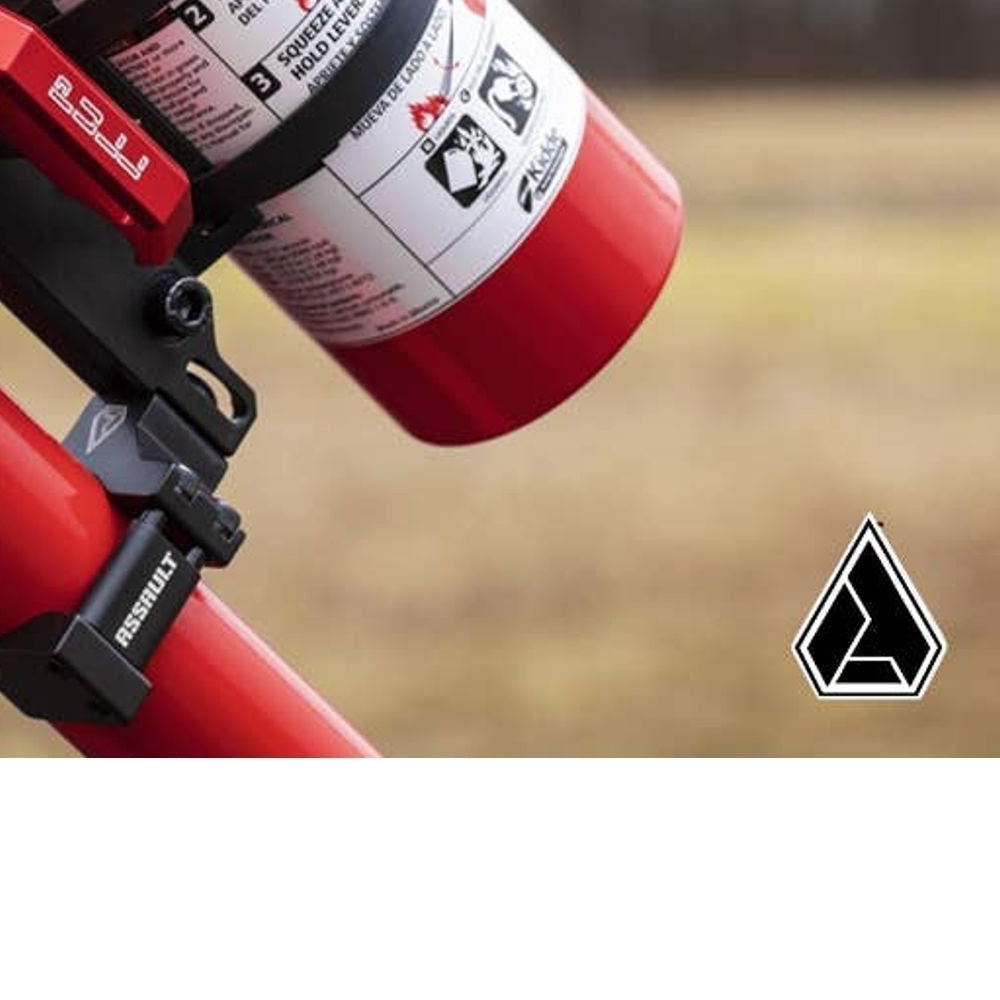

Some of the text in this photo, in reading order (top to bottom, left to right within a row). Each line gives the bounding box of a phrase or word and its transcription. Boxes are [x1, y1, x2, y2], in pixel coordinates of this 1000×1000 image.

[192, 6, 208, 25] 2
[237, 0, 264, 28] DEL
[290, 42, 331, 81] HOLD
[254, 72, 273, 92] 3
[350, 99, 390, 141] MUEVA
[387, 78, 404, 100] DE
[401, 48, 427, 92] LADO
[113, 550, 178, 649] ASSAULT
